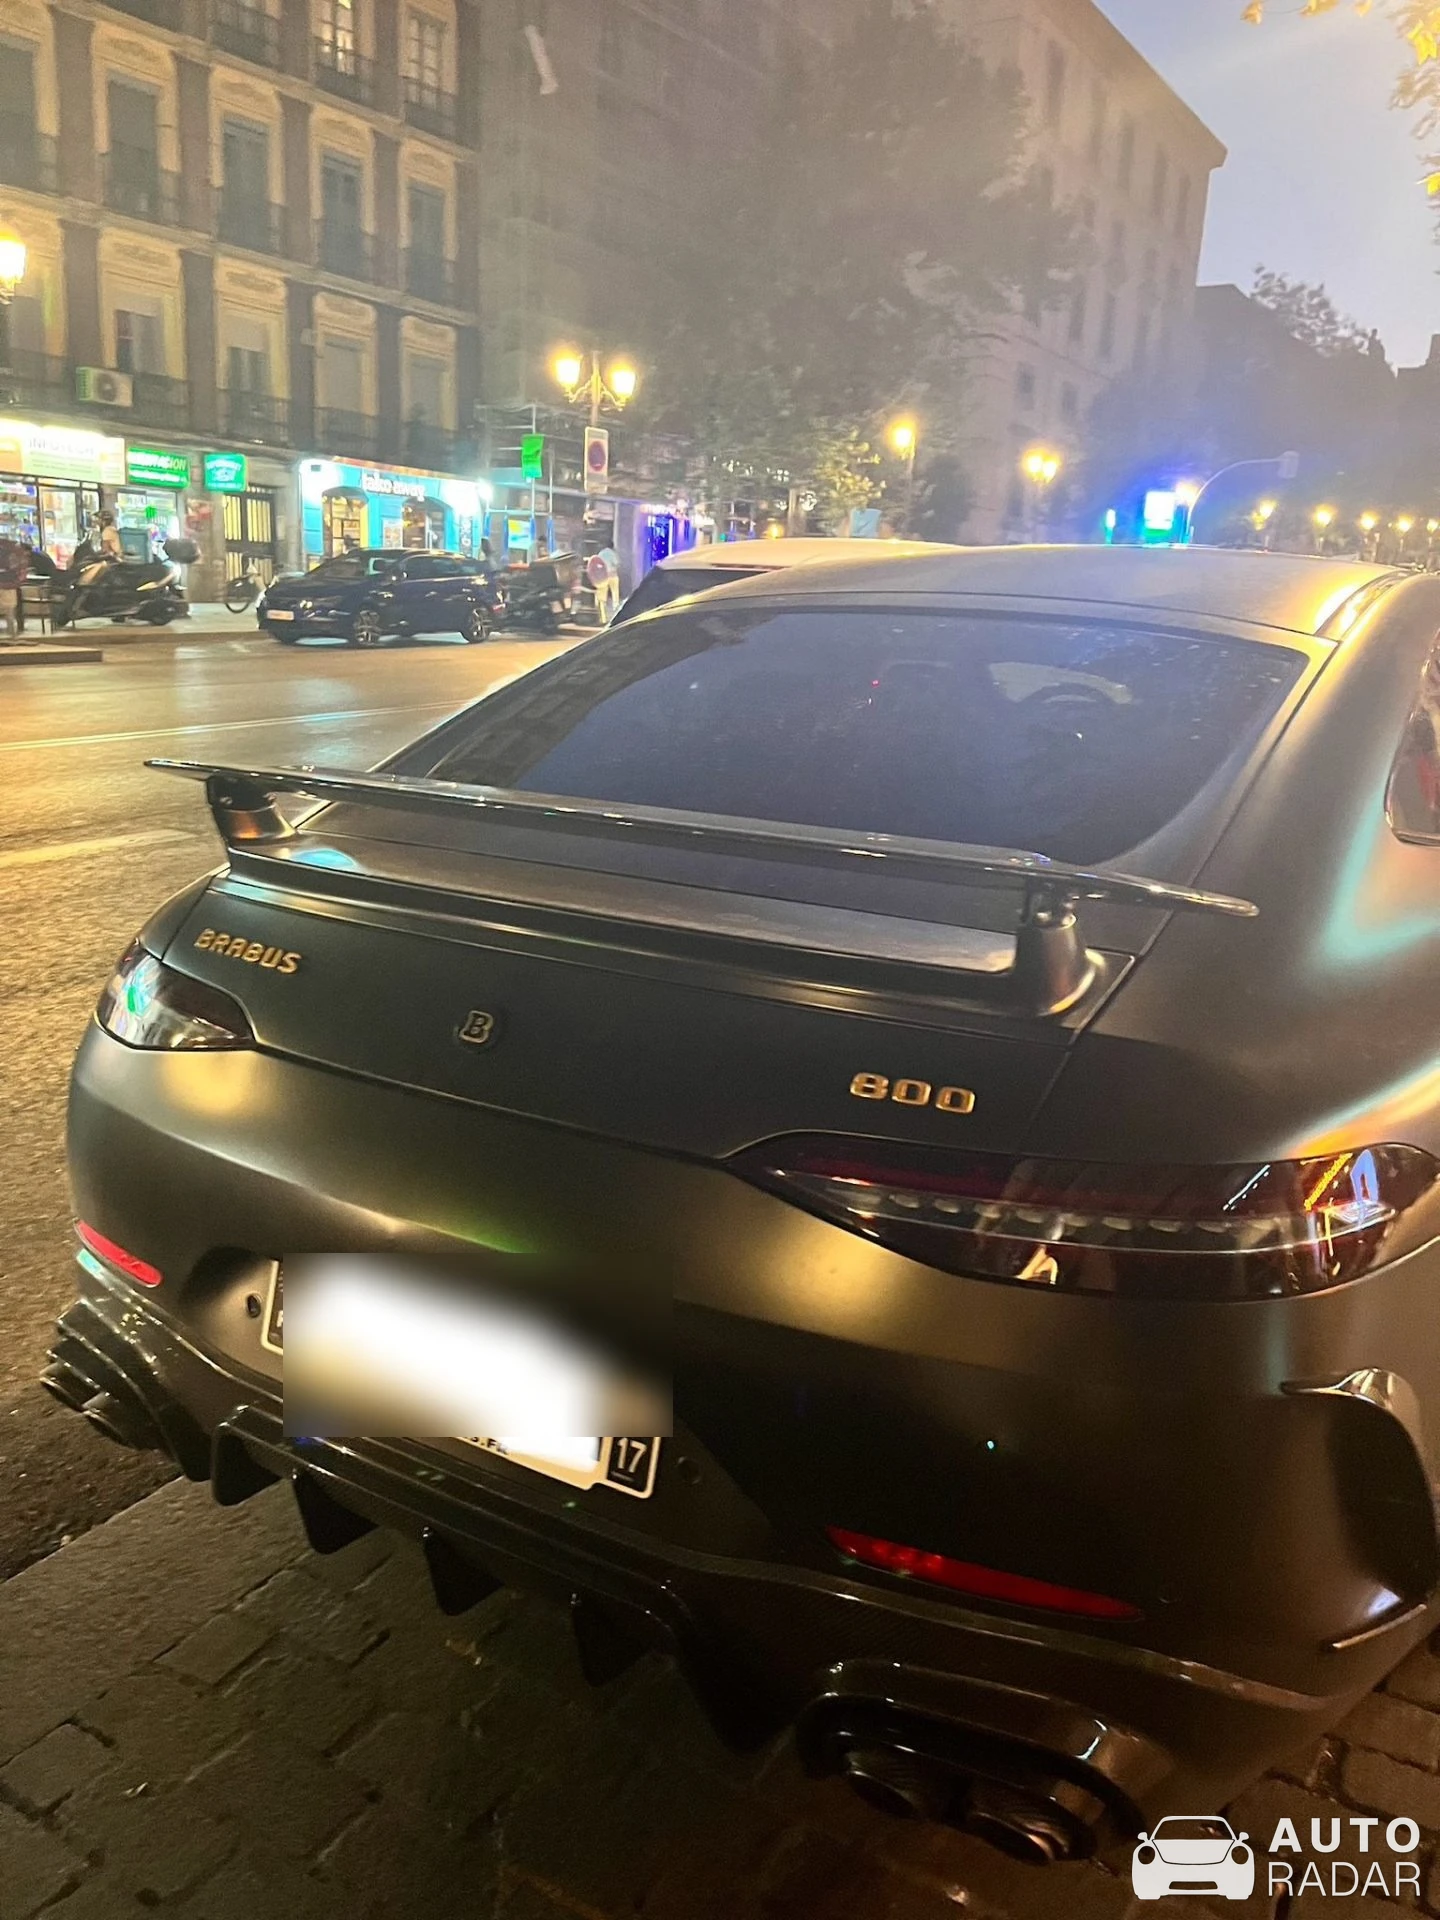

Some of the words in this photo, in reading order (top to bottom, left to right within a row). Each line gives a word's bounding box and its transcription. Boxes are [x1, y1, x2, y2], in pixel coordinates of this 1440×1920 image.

[194, 928, 301, 973] BRABUS
[459, 1009, 493, 1043] B
[850, 1072, 975, 1113] 800
[617, 1437, 648, 1473] 17
